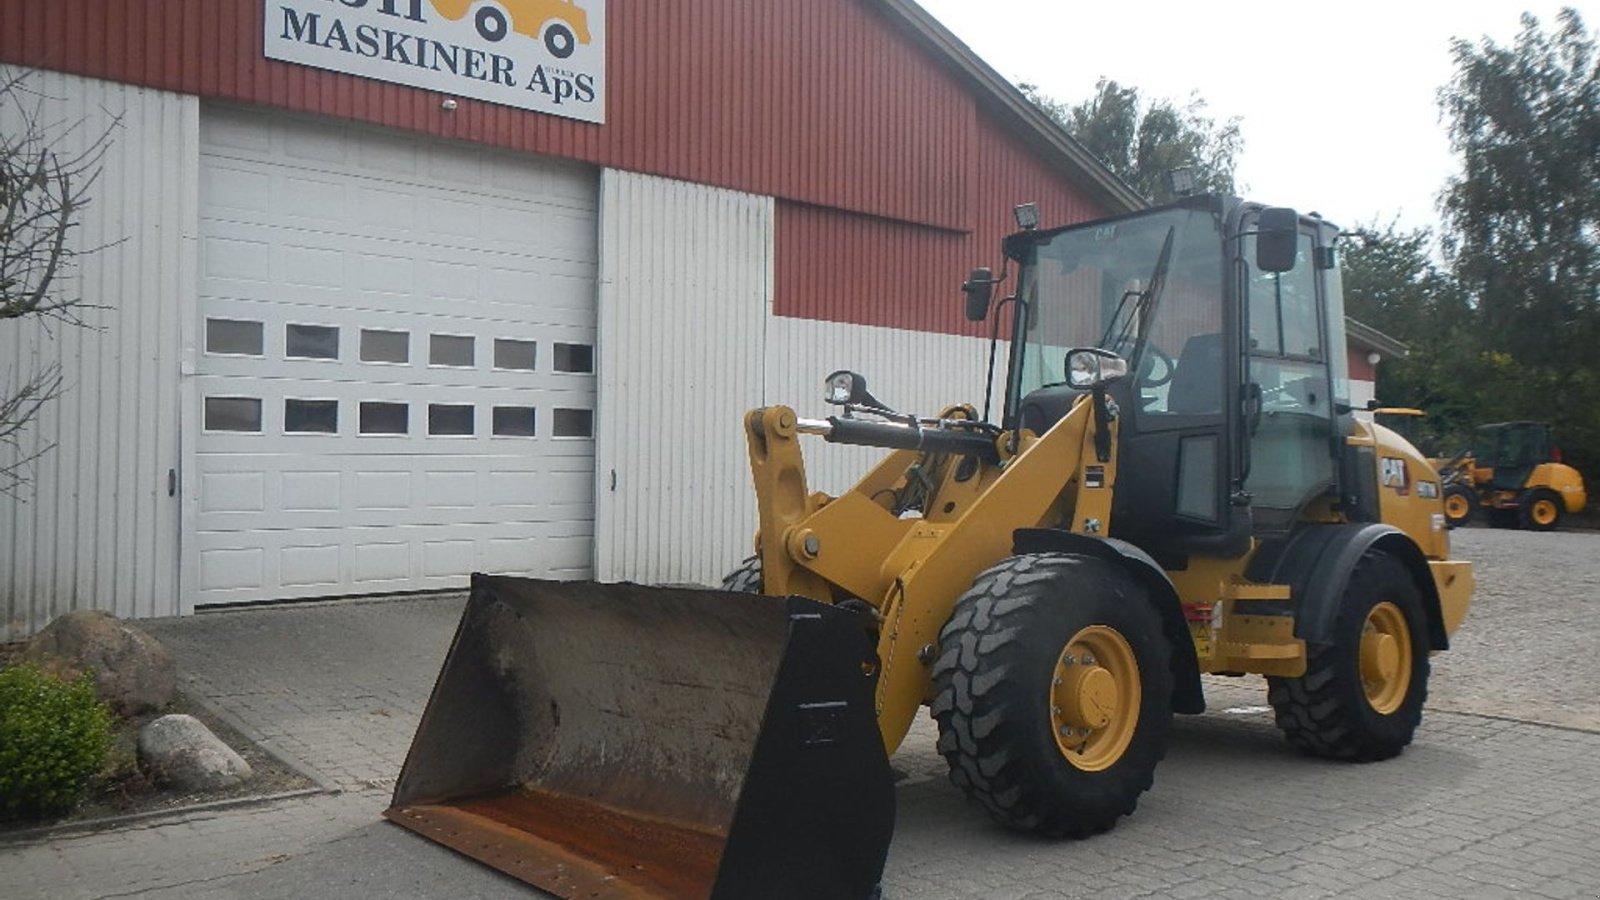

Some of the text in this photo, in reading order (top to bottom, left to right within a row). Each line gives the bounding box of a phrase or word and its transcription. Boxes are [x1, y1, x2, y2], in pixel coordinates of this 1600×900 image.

[280, 7, 595, 105] MASKINER ApS
[1381, 458, 1404, 488] CAT
